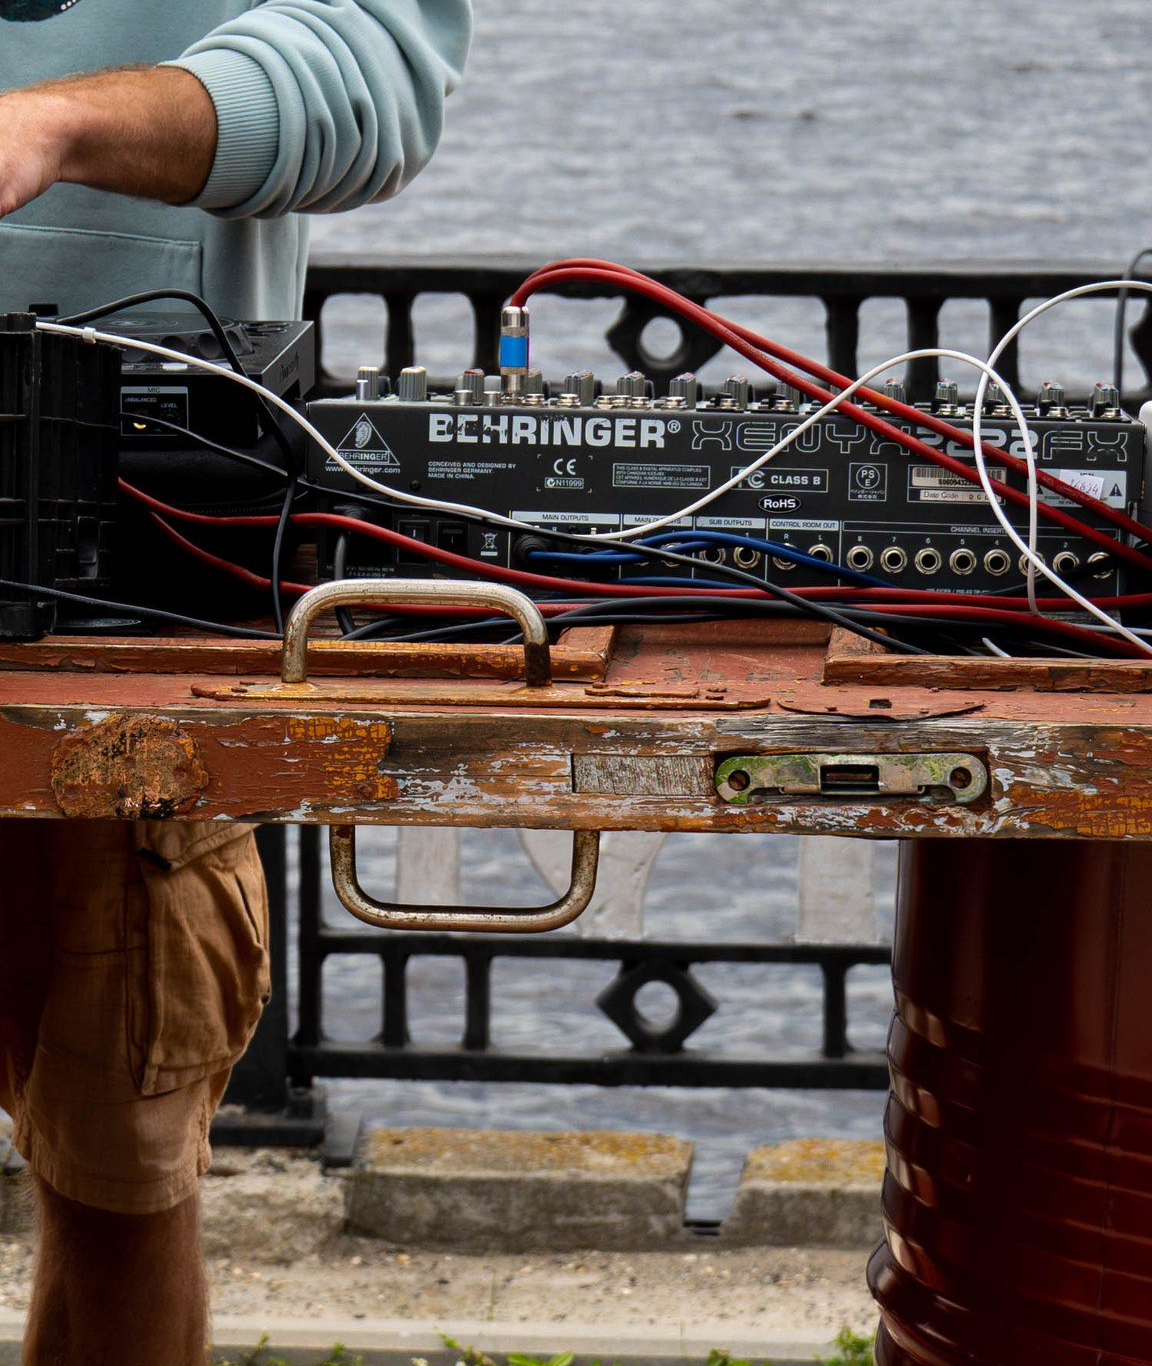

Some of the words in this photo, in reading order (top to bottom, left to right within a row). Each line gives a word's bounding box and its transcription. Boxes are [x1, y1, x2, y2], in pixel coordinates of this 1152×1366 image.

[339, 452, 388, 461] BEHRINGER
[771, 476, 808, 485] CLASS
[813, 476, 821, 485] B
[924, 491, 939, 499] Date
[941, 492, 959, 500] Code
[764, 499, 796, 509] RoHS
